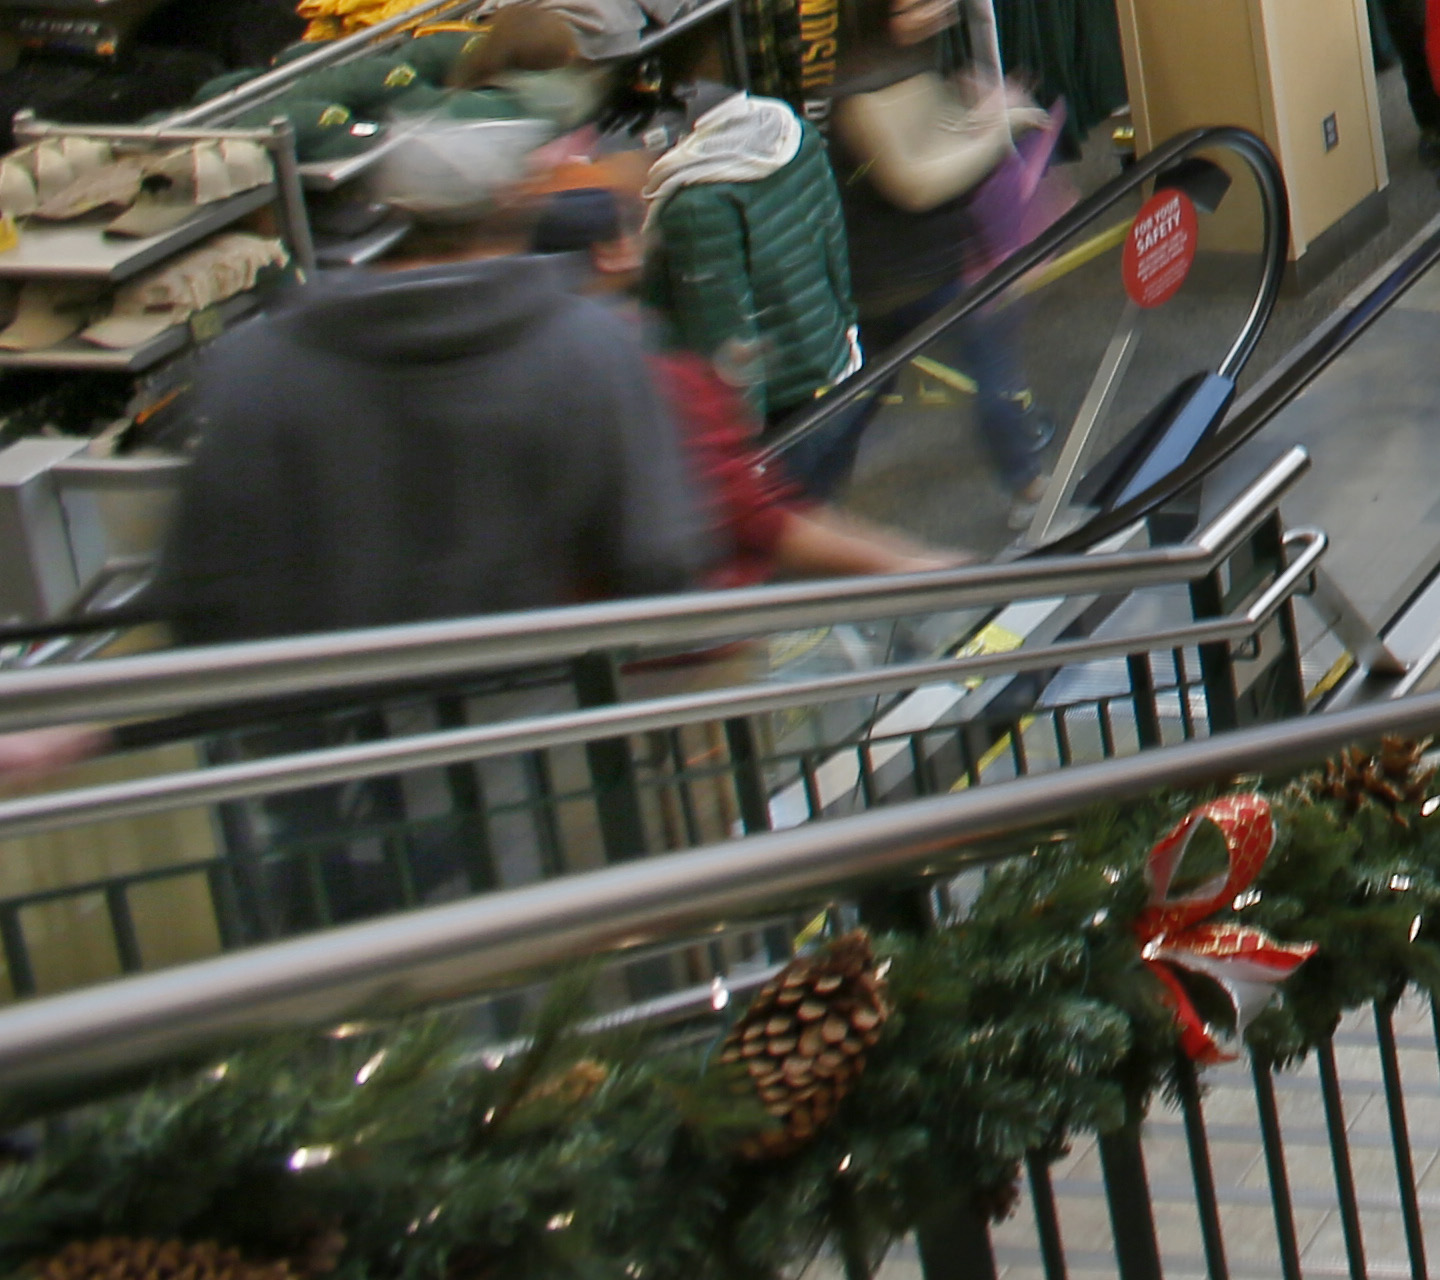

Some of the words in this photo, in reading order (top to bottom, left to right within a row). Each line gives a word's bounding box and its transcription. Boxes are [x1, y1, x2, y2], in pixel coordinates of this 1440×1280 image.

[1135, 216, 1154, 240] FOR
[1154, 195, 1180, 223] YOUR
[1137, 208, 1181, 258] SAFETY
